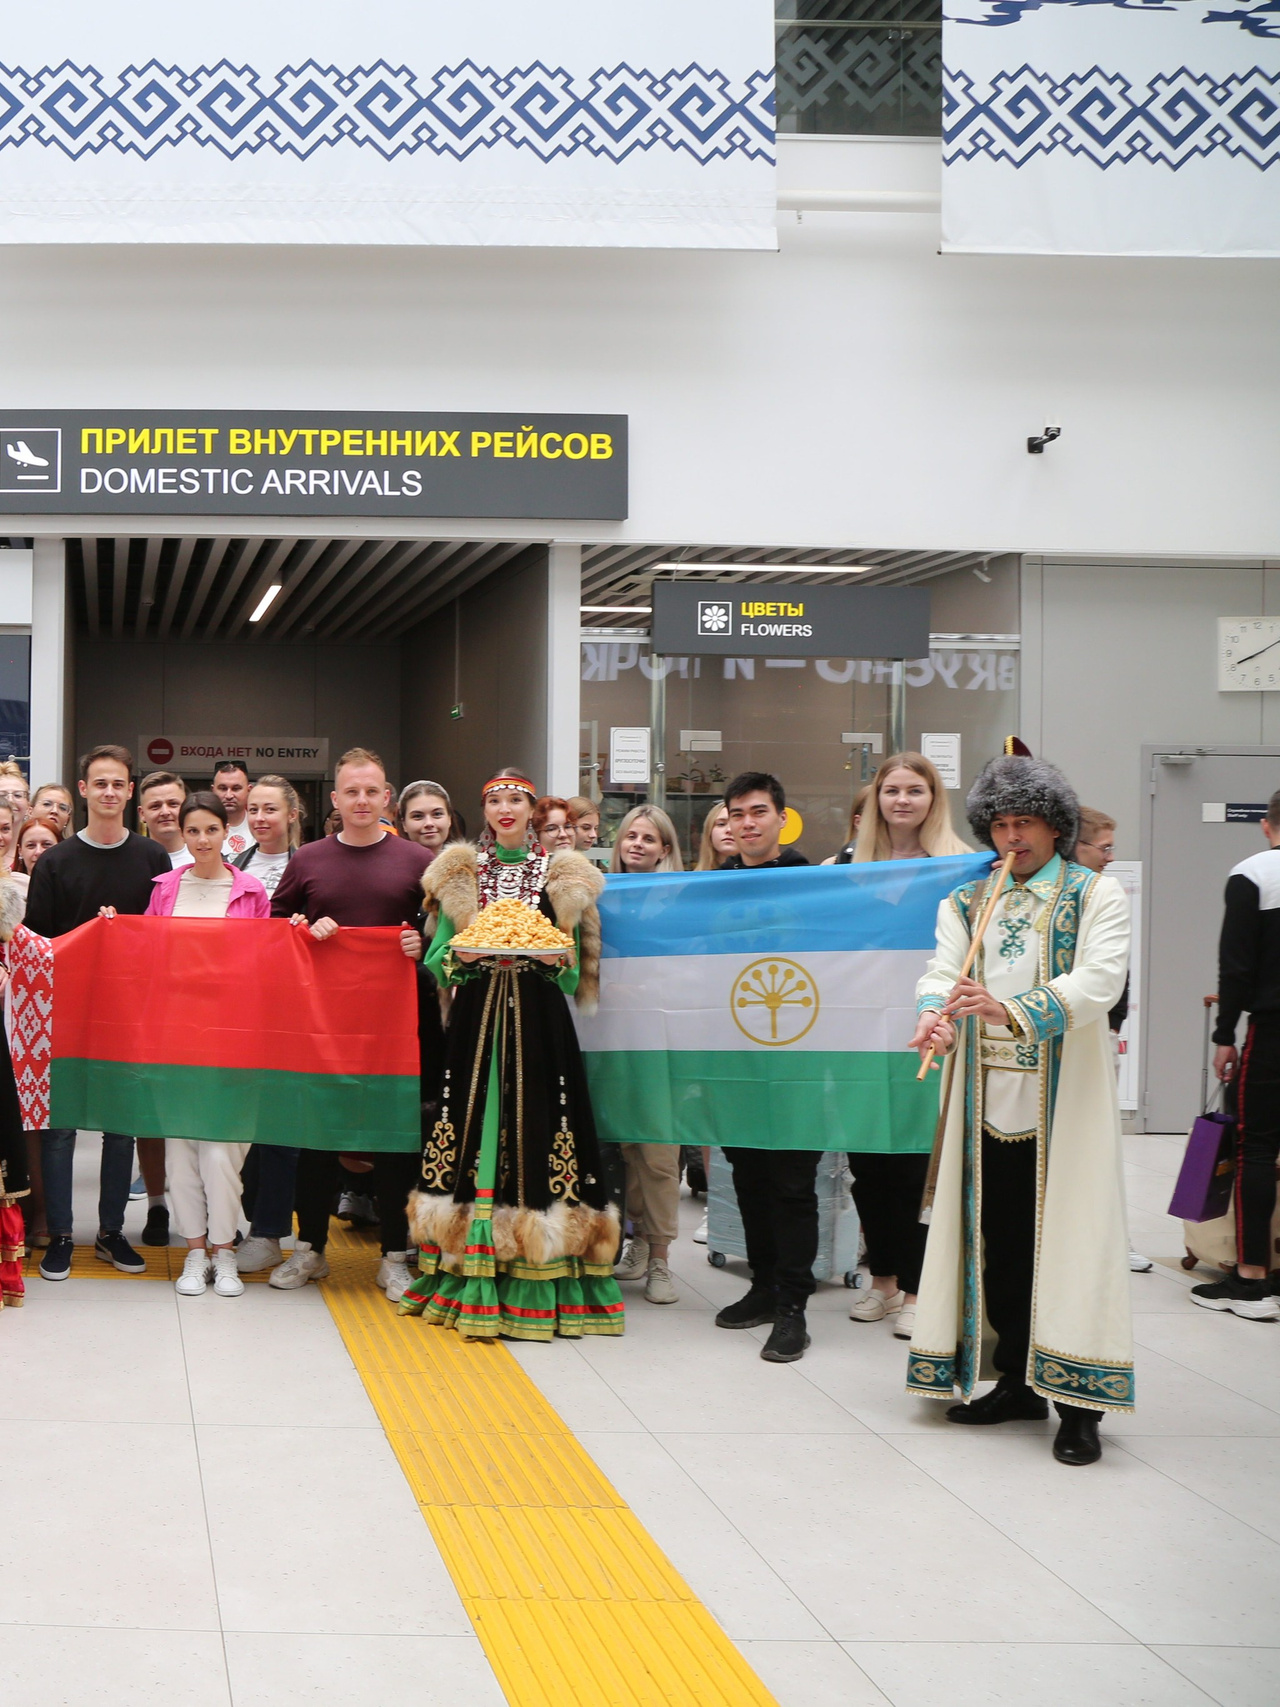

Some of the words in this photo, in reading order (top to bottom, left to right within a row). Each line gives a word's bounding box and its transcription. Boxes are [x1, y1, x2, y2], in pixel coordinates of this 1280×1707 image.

[80, 428, 219, 455] ПРИЛЕТ
[228, 429, 462, 458] ВНУТРЕННИХ
[471, 425, 613, 460] РЕЙСОВ
[80, 466, 254, 495] DOMESTIC
[261, 468, 423, 496] ARRIVALS
[741, 602, 804, 618] ЦВЕТЫ
[741, 624, 813, 637] FLOWERS
[180, 746, 224, 758] ВХОДА
[227, 747, 253, 757] НЕТ
[256, 747, 274, 758] NO
[278, 748, 319, 758] ENTRY
